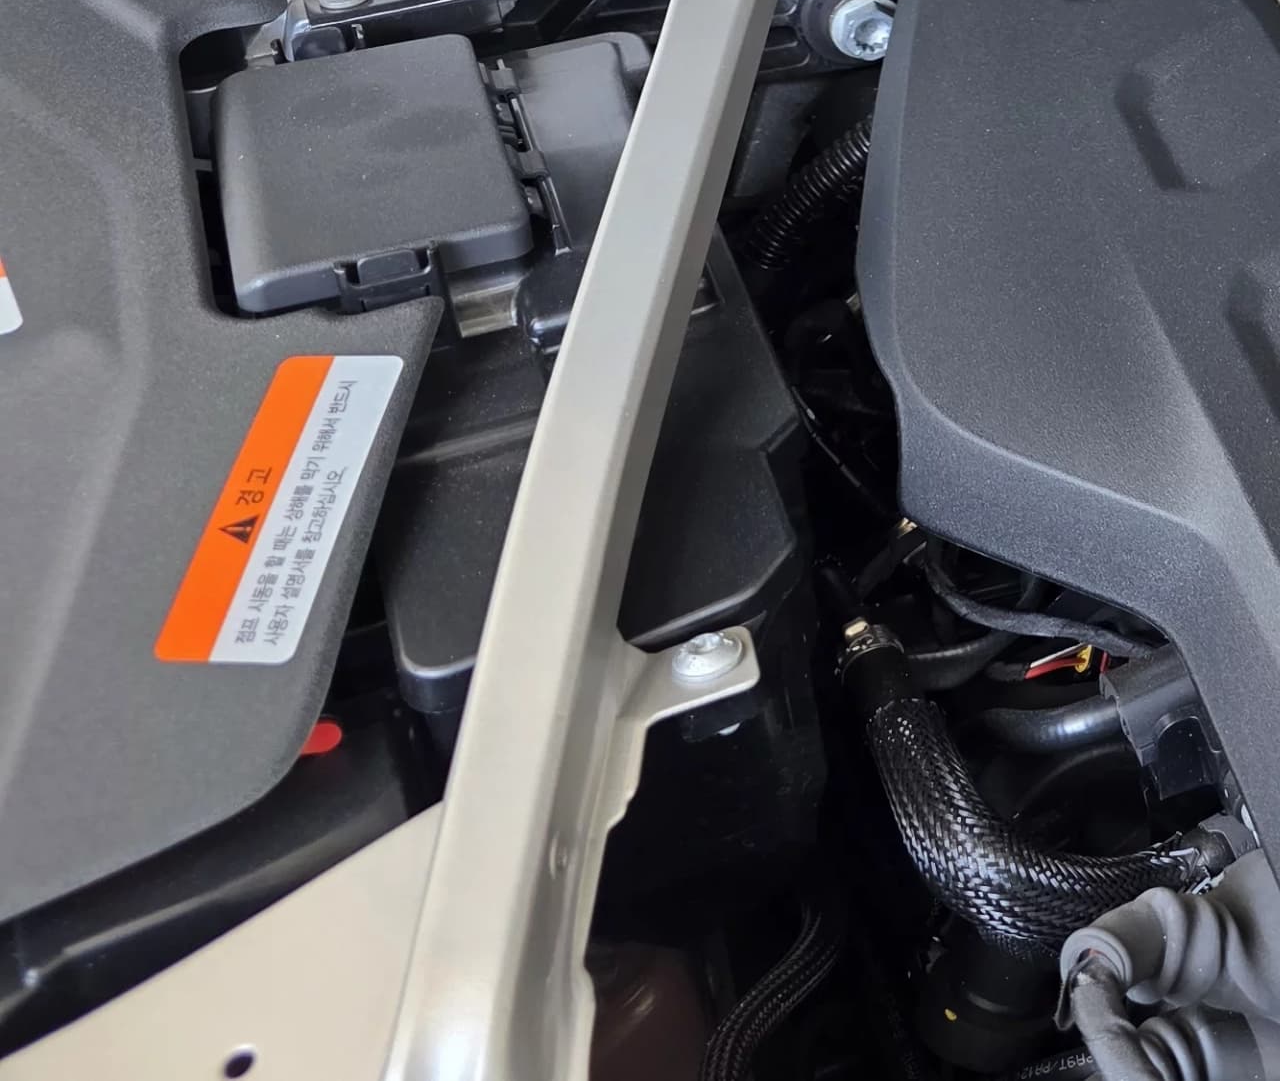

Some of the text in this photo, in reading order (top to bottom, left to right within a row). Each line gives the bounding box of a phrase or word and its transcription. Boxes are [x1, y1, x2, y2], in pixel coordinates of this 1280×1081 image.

[327, 380, 358, 414] 반드시
[311, 417, 341, 453] 위해서
[234, 466, 273, 506] 경고
[299, 456, 326, 481] 막기
[283, 484, 314, 522] 상해를
[272, 525, 298, 551] 때는
[263, 555, 286, 568] 할
[247, 572, 279, 613] 시동을
[263, 604, 295, 646] 사용자
[280, 548, 316, 600] 설명서를
